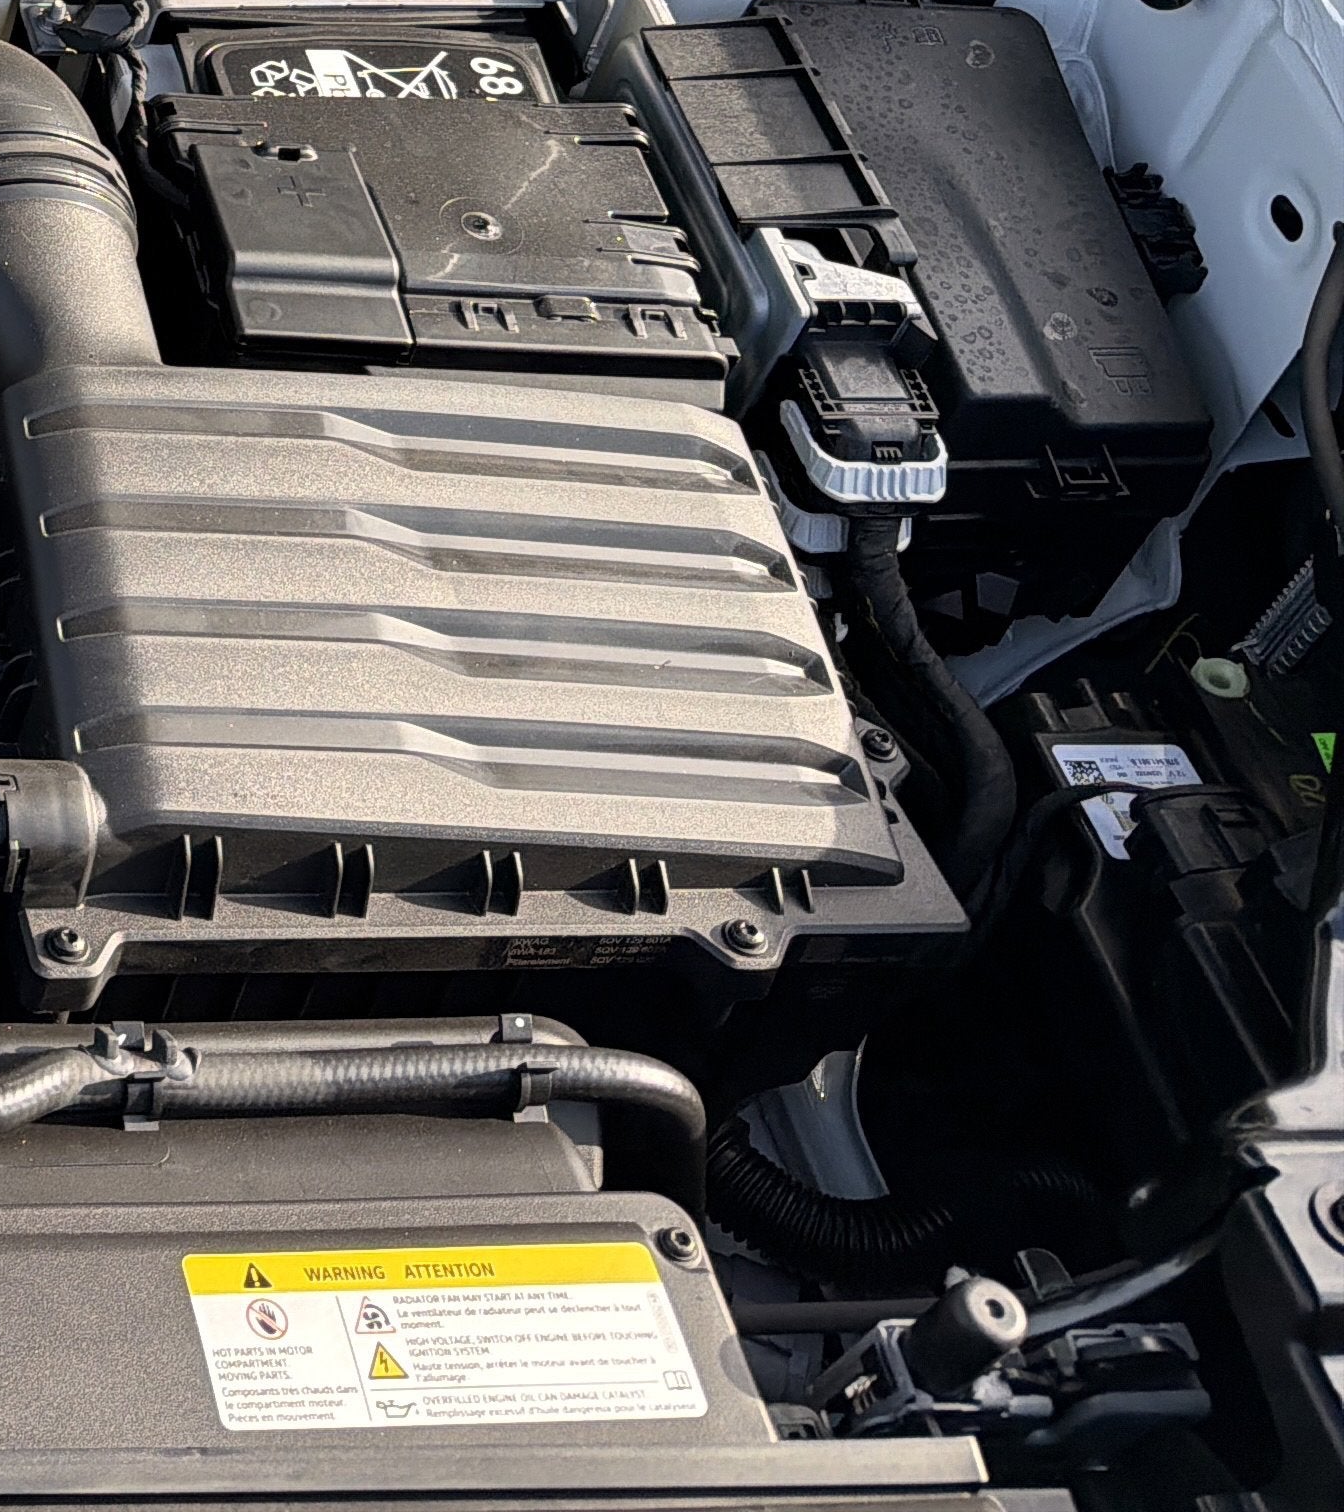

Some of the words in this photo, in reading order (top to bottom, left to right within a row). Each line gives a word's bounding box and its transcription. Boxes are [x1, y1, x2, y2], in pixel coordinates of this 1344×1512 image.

[303, 1265, 385, 1282] WARNING
[404, 1262, 496, 1280] ATTENTION
[213, 1348, 232, 1357] HOT
[234, 1347, 264, 1357] PARTS
[266, 1347, 276, 1356] IN
[278, 1346, 313, 1356] MOTOR
[218, 1371, 257, 1381] MOVING
[222, 1387, 280, 1397] Composants
